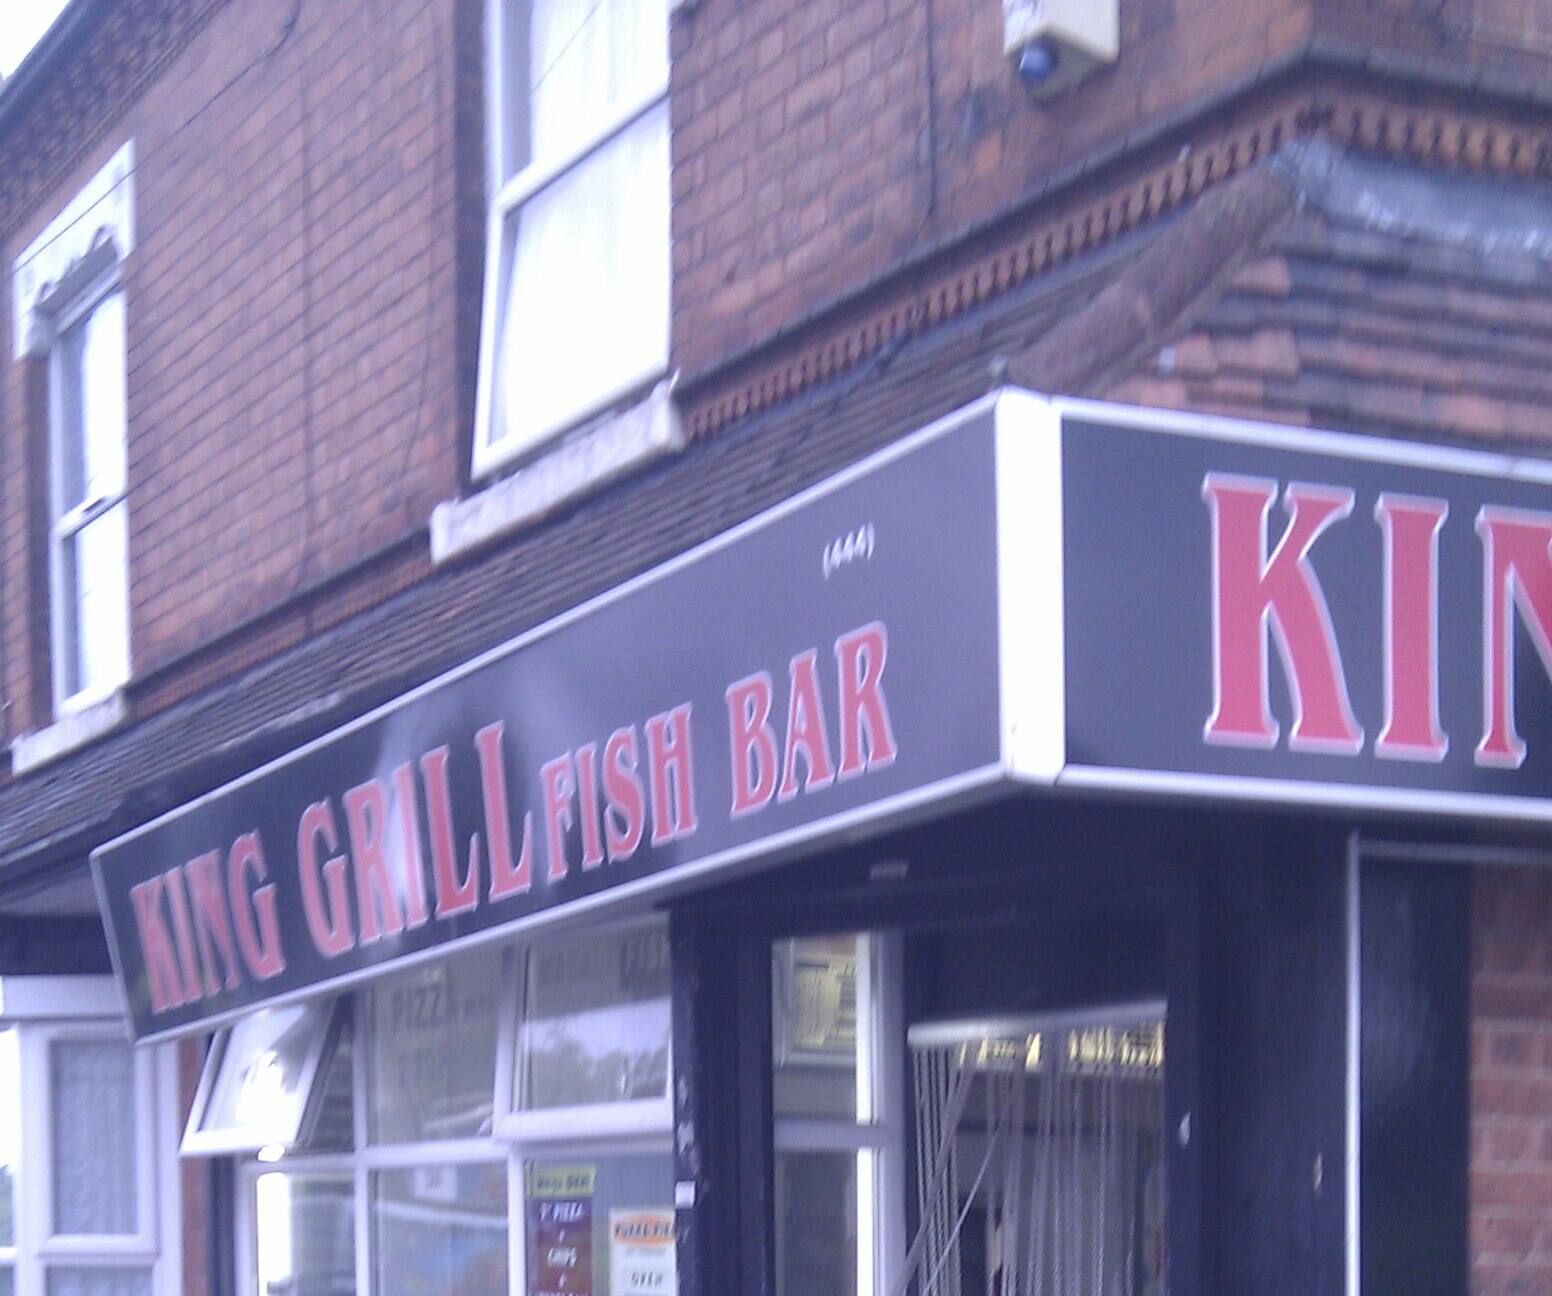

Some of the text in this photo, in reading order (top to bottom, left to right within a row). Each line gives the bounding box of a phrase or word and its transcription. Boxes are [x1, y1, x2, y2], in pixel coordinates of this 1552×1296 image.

[129, 619, 898, 1013] KING GRILL FISH BAR
